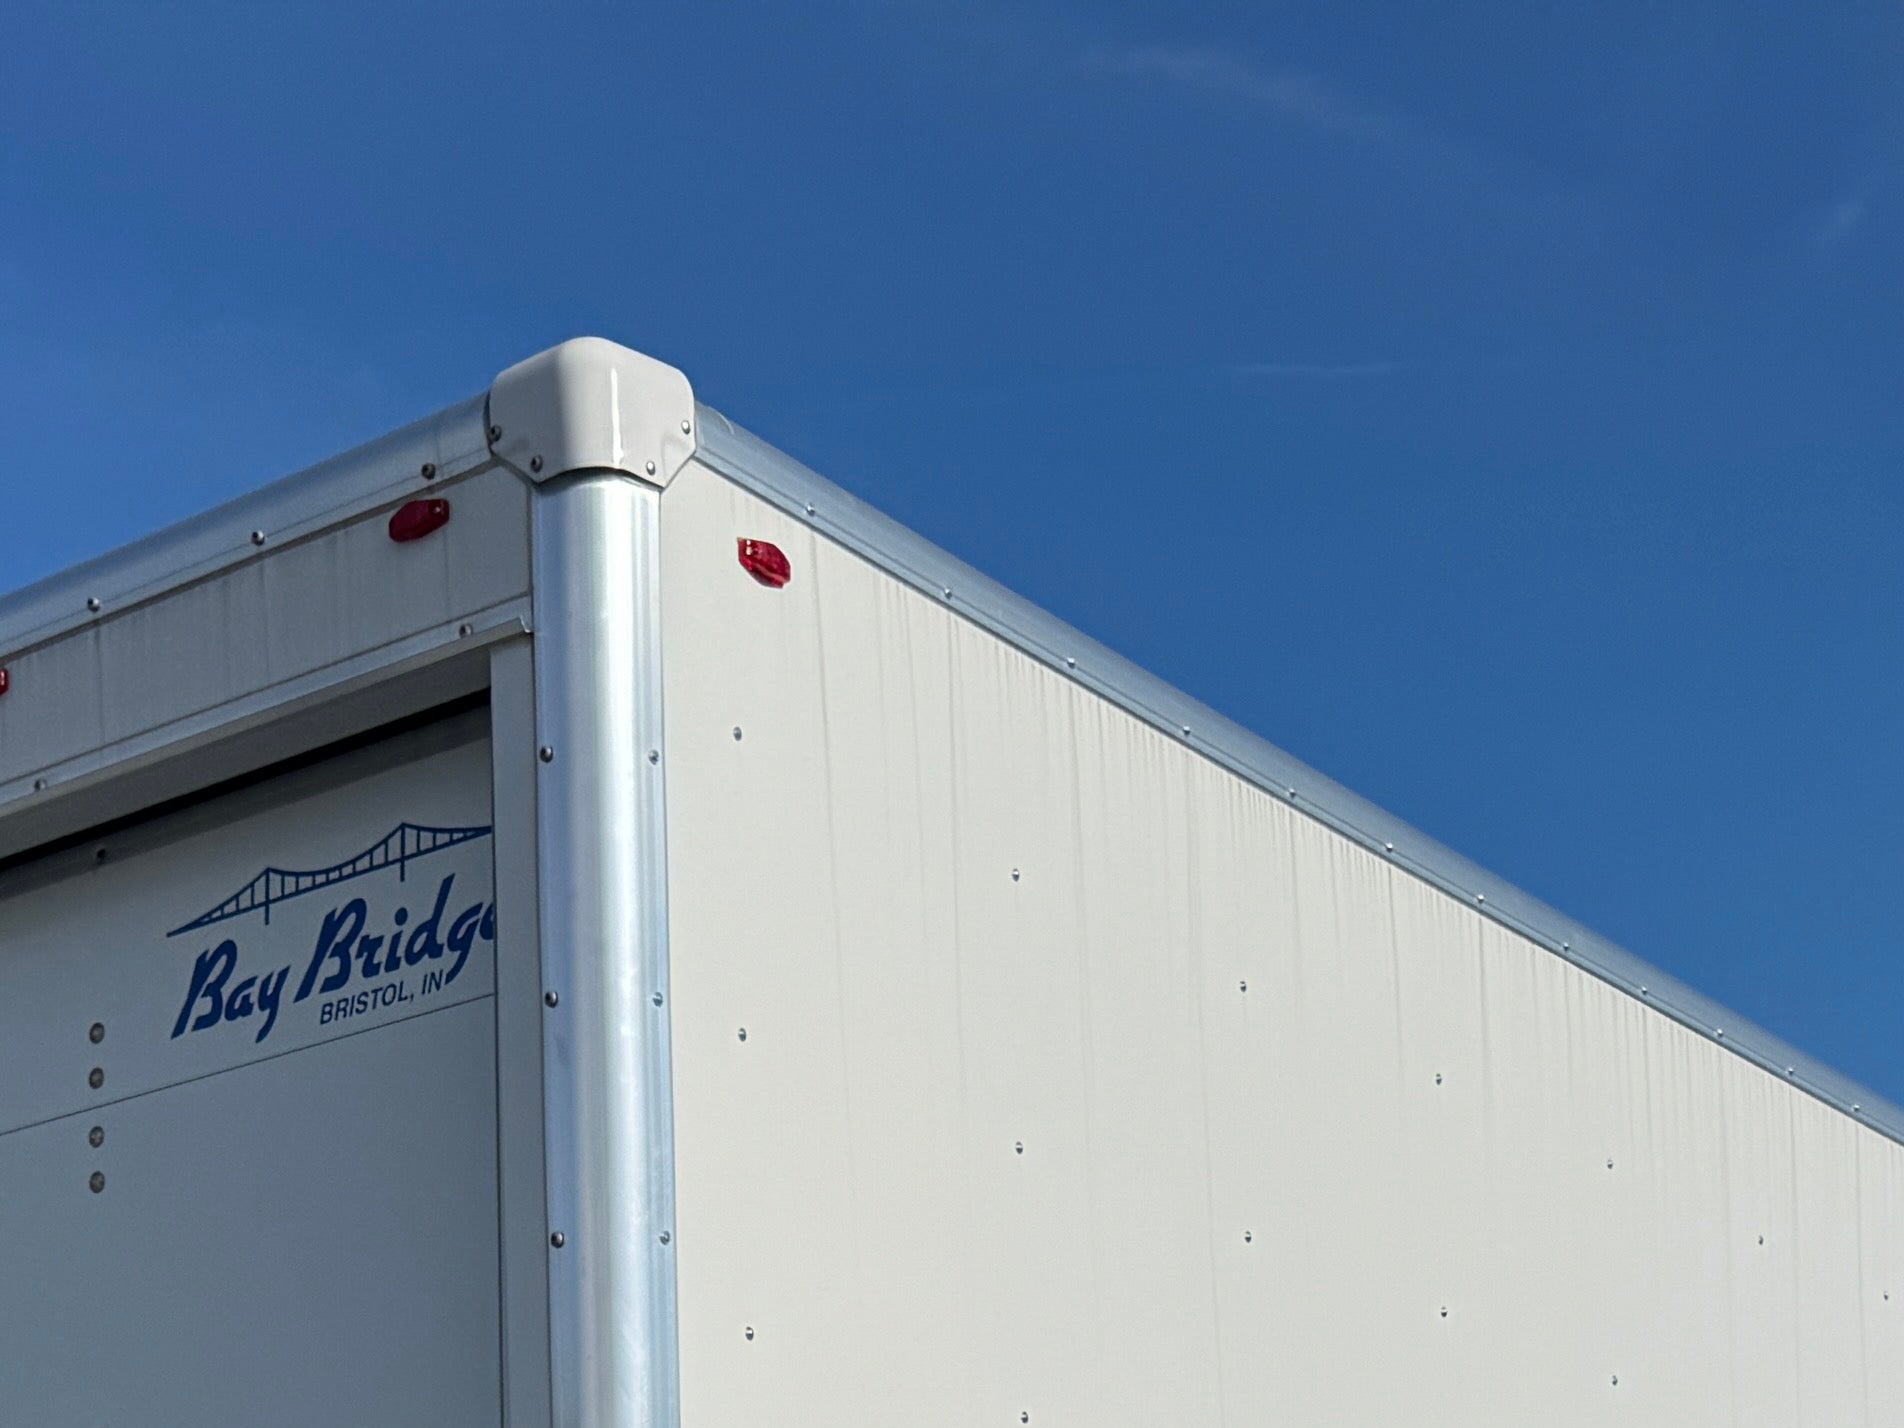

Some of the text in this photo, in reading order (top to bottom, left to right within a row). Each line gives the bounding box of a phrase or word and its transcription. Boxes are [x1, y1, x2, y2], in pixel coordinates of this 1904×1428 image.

[171, 939, 291, 1044] Bay
[320, 969, 444, 1025] BRISTOL, IN
